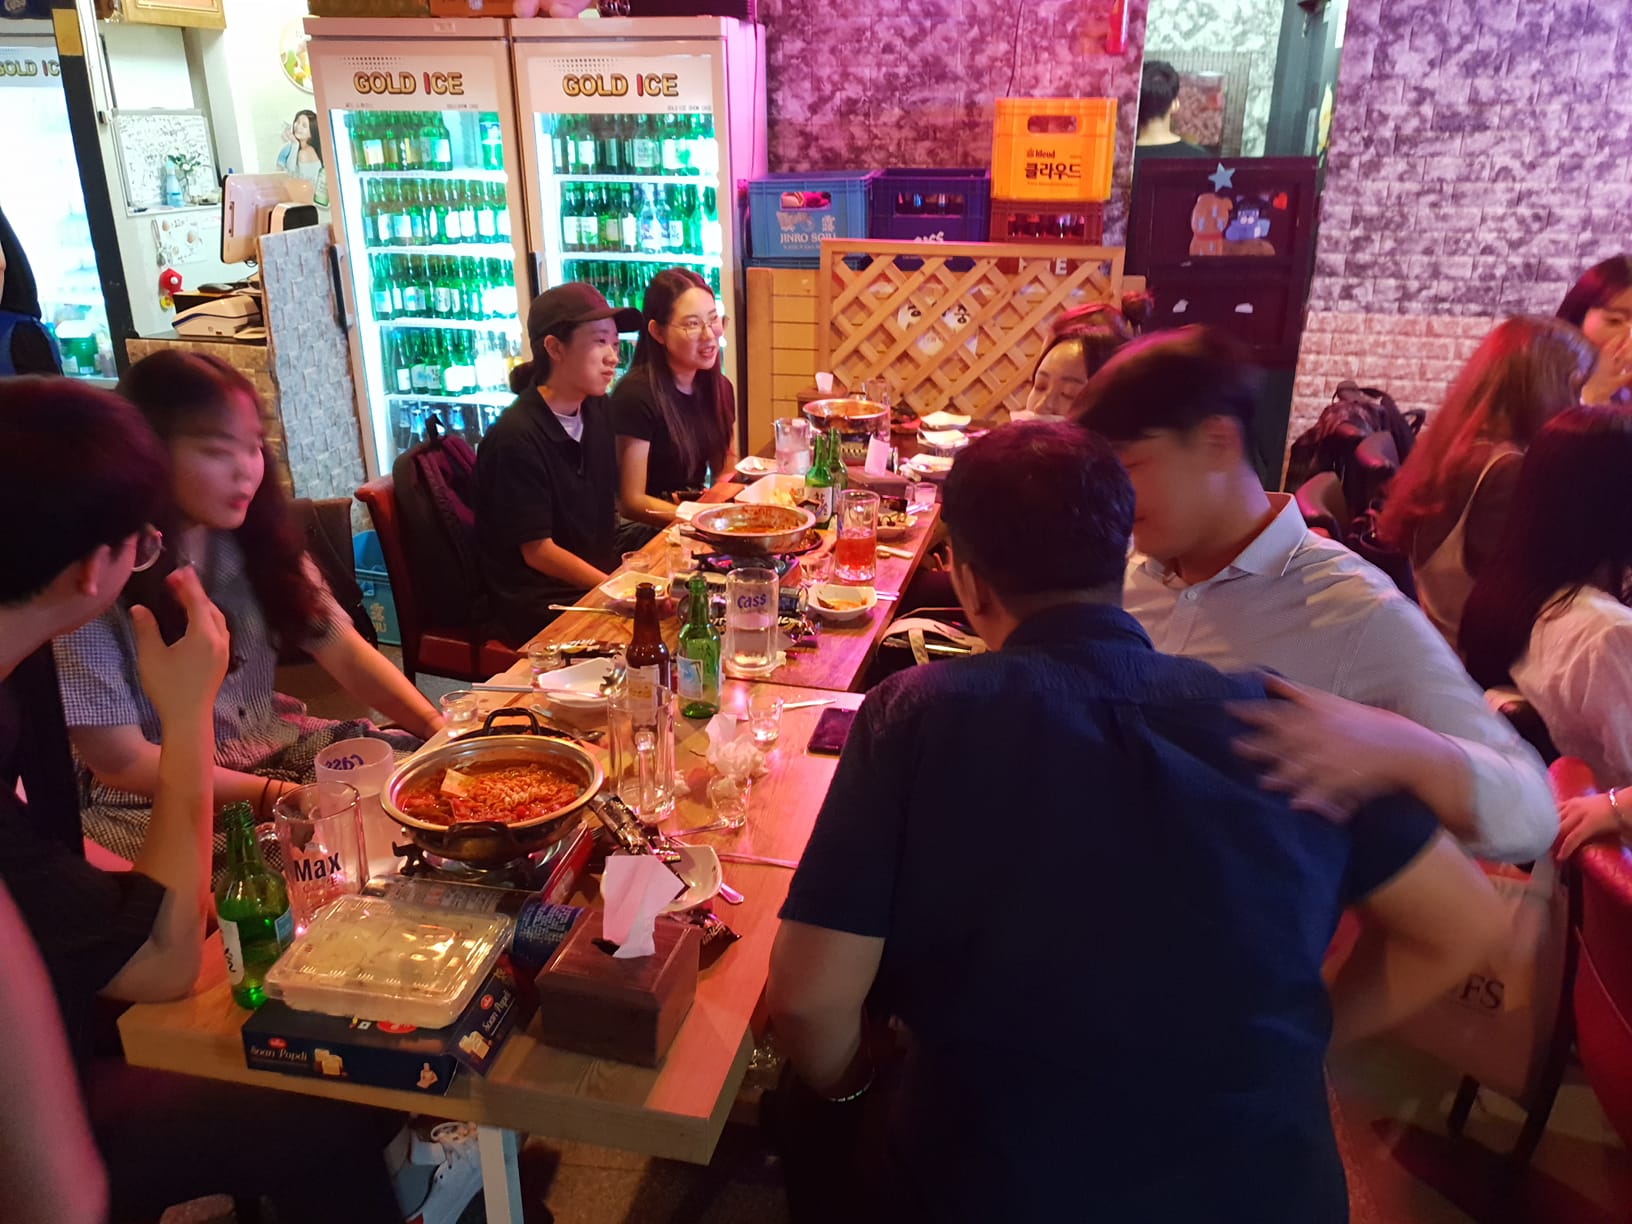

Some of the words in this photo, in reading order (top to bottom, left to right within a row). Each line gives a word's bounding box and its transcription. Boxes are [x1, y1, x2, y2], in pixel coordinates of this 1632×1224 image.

[353, 71, 417, 95] GOLD
[423, 72, 465, 96] ICE
[562, 73, 629, 97] GOLD
[636, 73, 679, 97] ICE
[1025, 162, 1082, 181] 클라우드
[780, 232, 809, 244] JINRO
[736, 593, 768, 609] Cass
[294, 851, 342, 882] Max
